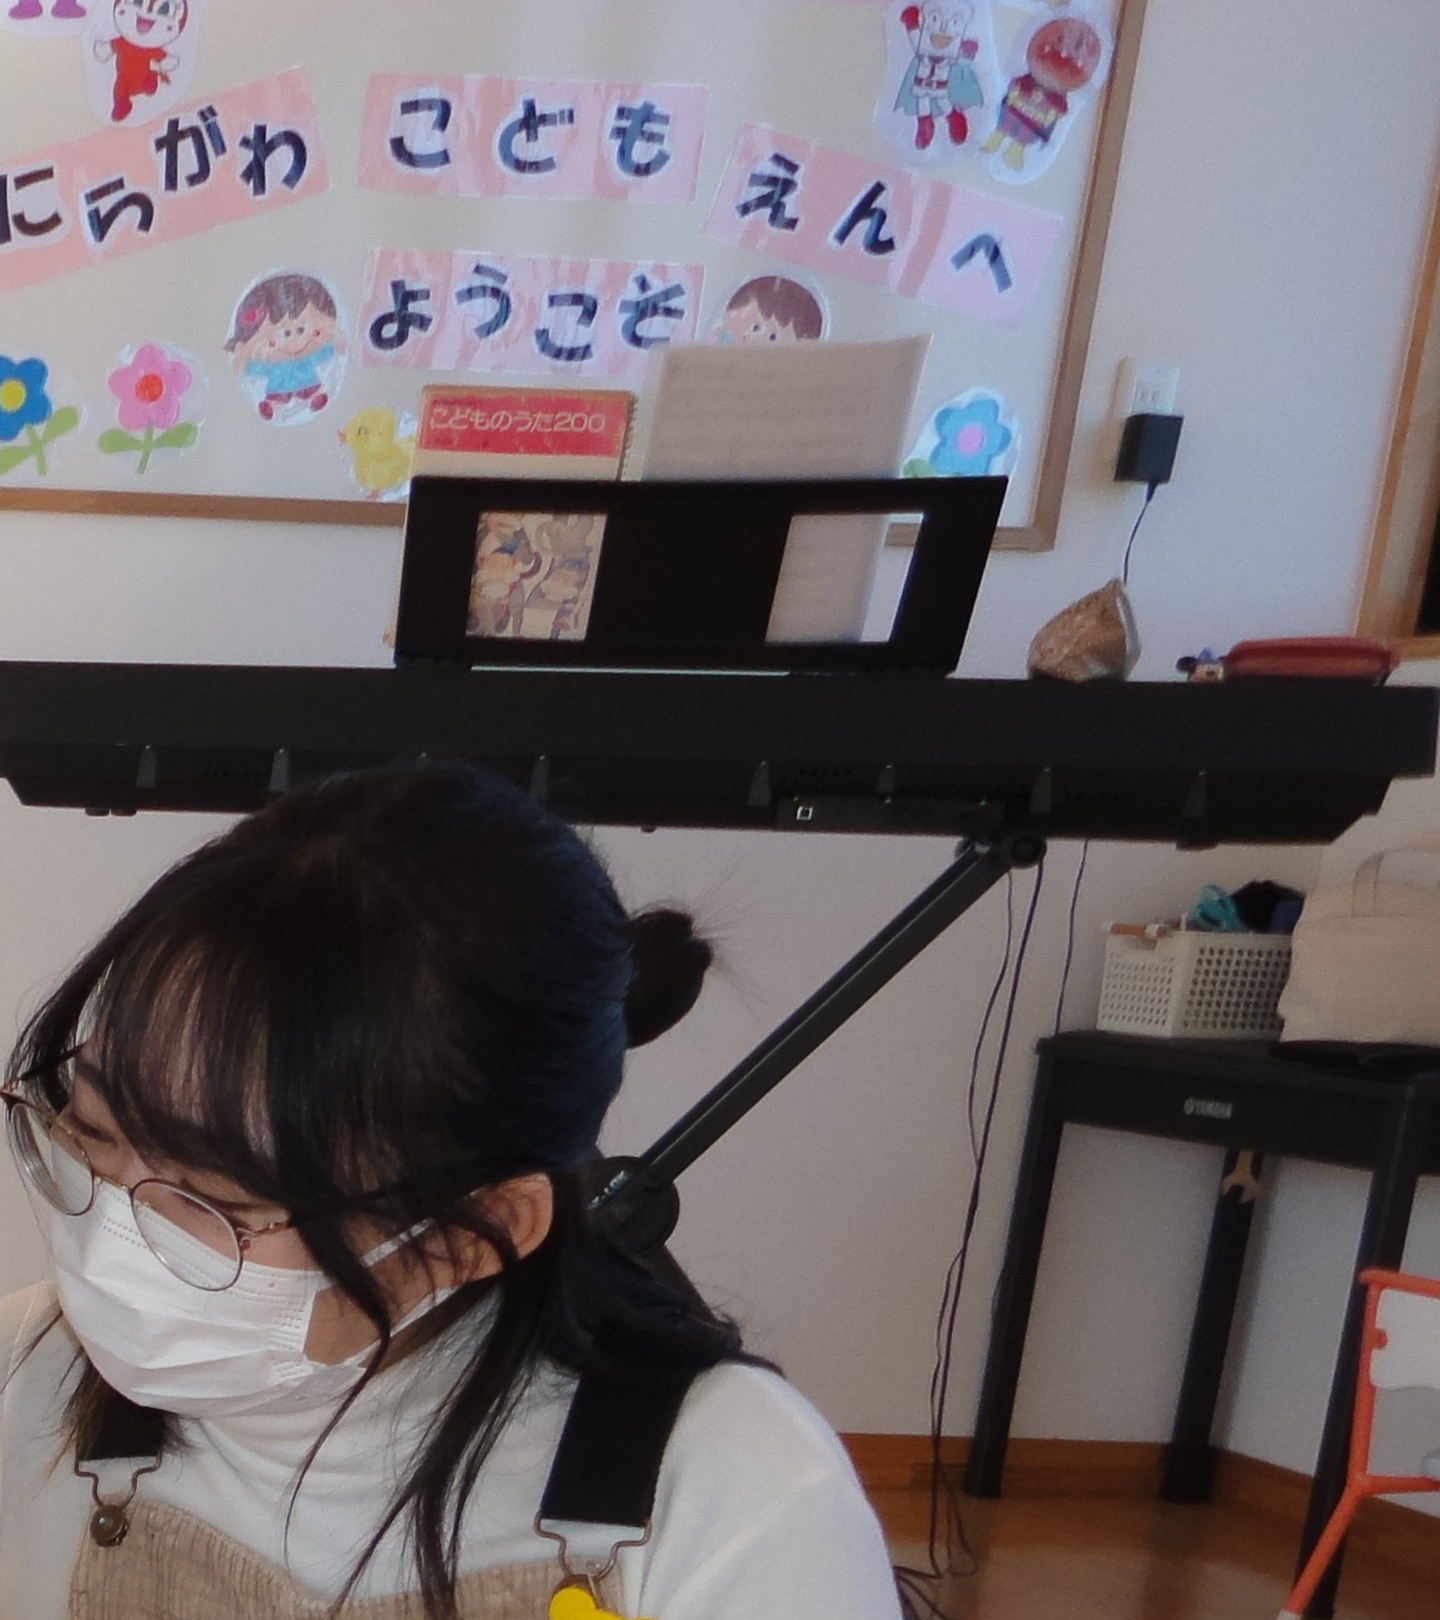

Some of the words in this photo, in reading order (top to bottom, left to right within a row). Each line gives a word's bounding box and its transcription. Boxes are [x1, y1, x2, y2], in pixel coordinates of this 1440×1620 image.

[388, 97, 670, 178] こども
[369, 262, 686, 362] ようこそ
[430, 404, 606, 433] こどものうた200
